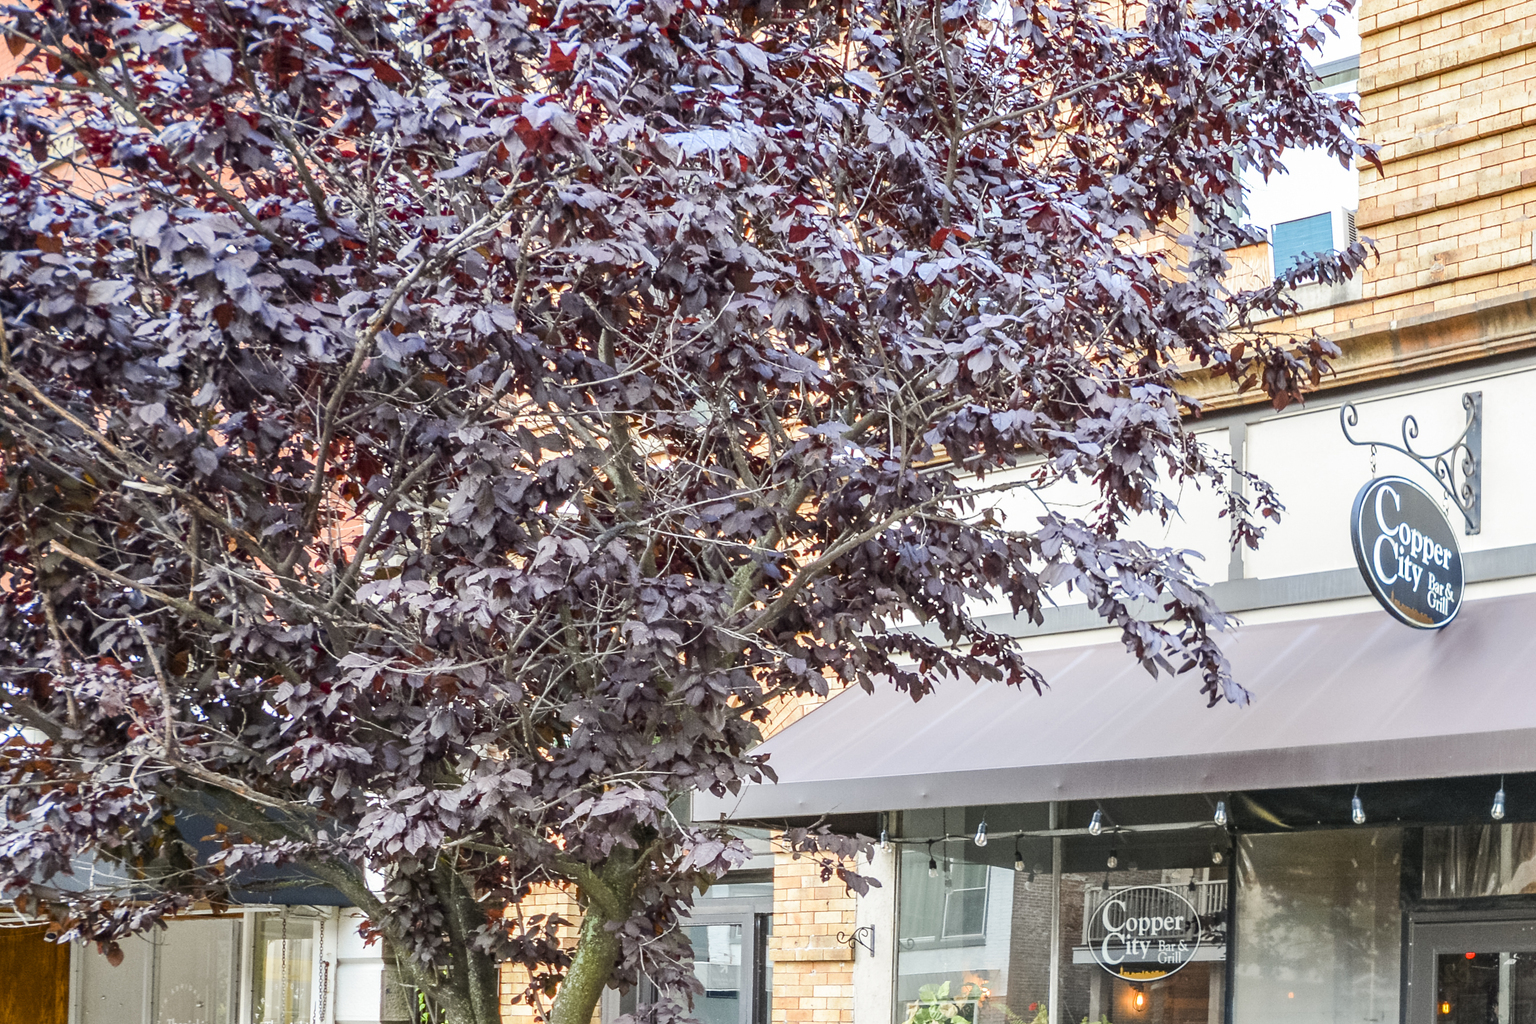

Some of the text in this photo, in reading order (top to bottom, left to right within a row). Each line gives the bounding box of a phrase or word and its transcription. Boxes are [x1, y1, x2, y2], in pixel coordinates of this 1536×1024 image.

[1375, 484, 1452, 570] Copper
[1373, 534, 1423, 592] City
[1428, 571, 1454, 602] Bar &
[1427, 592, 1448, 616] Grill
[1102, 899, 1184, 936] Copper
[1101, 932, 1151, 965] City
[1157, 951, 1182, 964] Grill
[1158, 939, 1189, 952] Bar &
